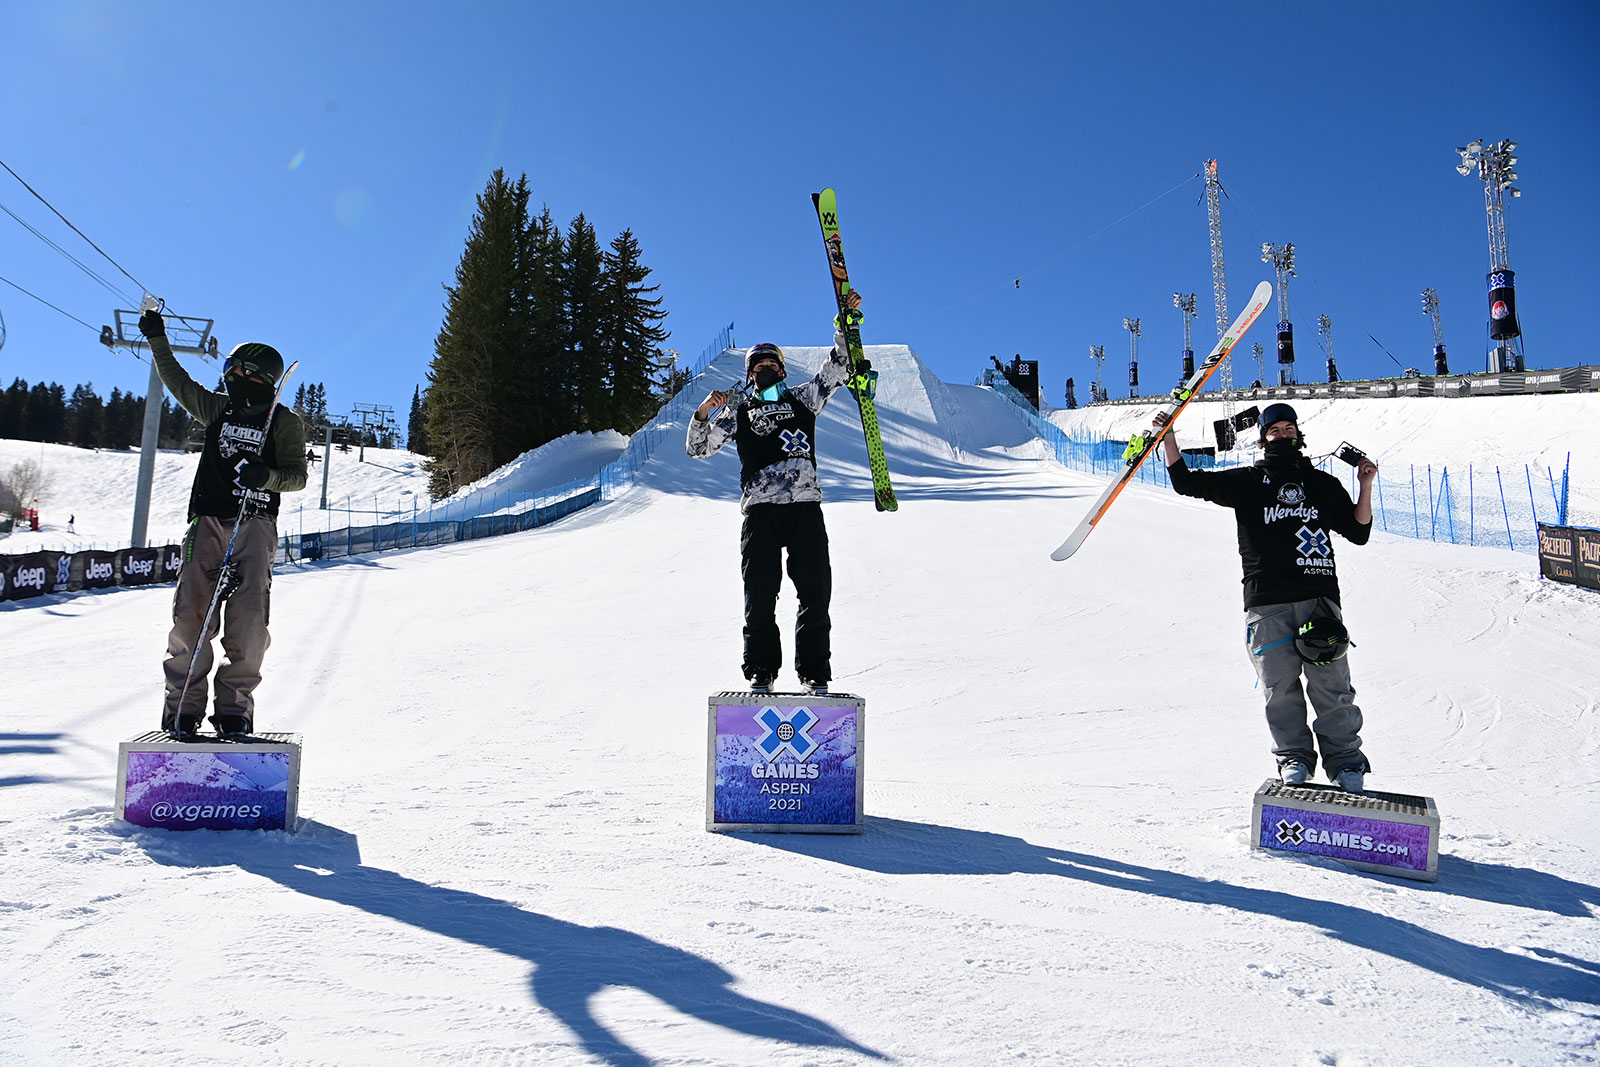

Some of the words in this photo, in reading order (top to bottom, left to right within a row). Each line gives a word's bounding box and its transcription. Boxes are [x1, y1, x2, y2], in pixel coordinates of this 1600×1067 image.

[1263, 502, 1319, 524] Wendy's
[86, 558, 113, 581] Jeep
[123, 556, 154, 576] Jeep
[1296, 557, 1334, 567] GAMES
[13, 564, 46, 590] Jeep
[1303, 568, 1333, 576] ASPEN
[751, 763, 820, 779] GAMES
[760, 783, 811, 795] ASPEN
[150, 801, 262, 822] @xgames
[769, 798, 802, 810] 2021
